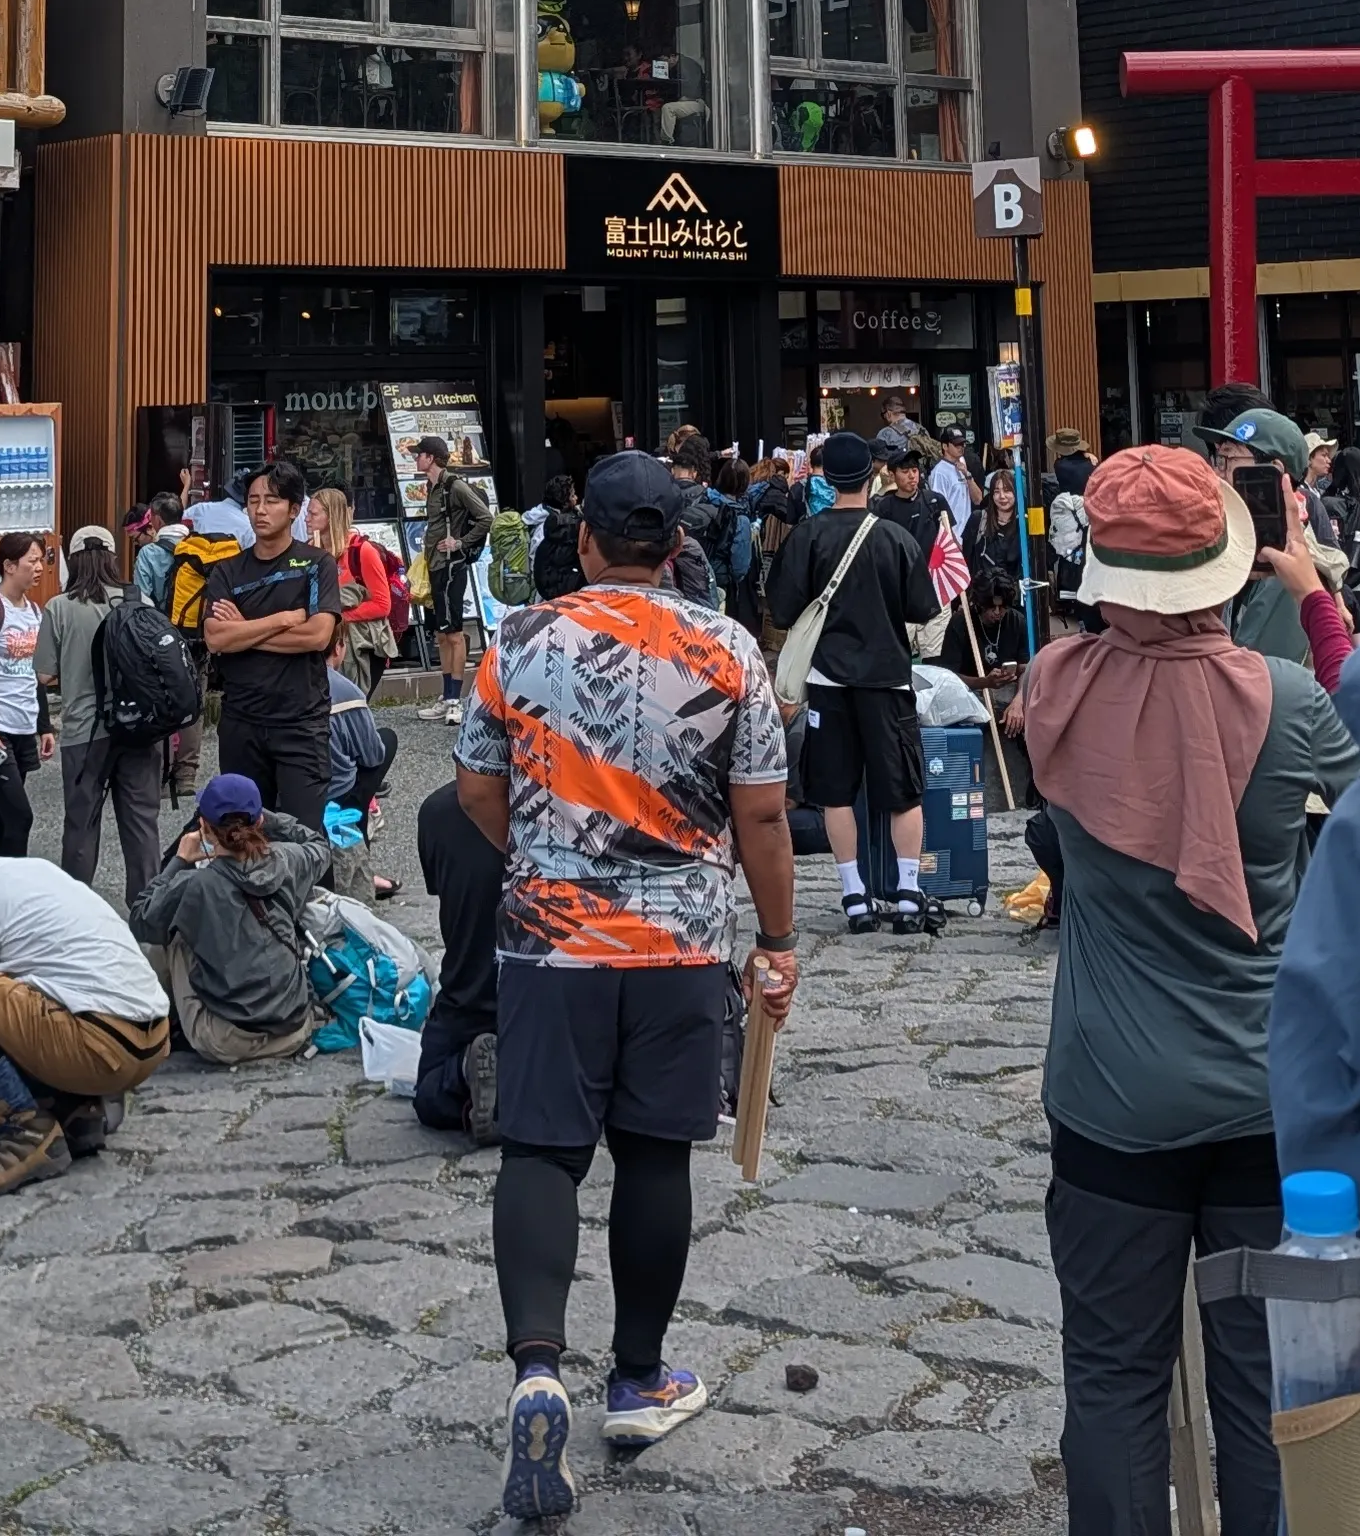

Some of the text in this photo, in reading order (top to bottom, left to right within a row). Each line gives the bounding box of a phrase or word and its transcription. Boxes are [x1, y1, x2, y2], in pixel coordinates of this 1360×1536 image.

[993, 182, 1024, 229] B
[605, 216, 747, 248] 富士山みはらし
[606, 248, 747, 261] MOUNT FUJI MIHARASHI
[853, 310, 921, 330] Coffee
[383, 385, 399, 397] 2F
[392, 393, 477, 409] みはらし Kitchen
